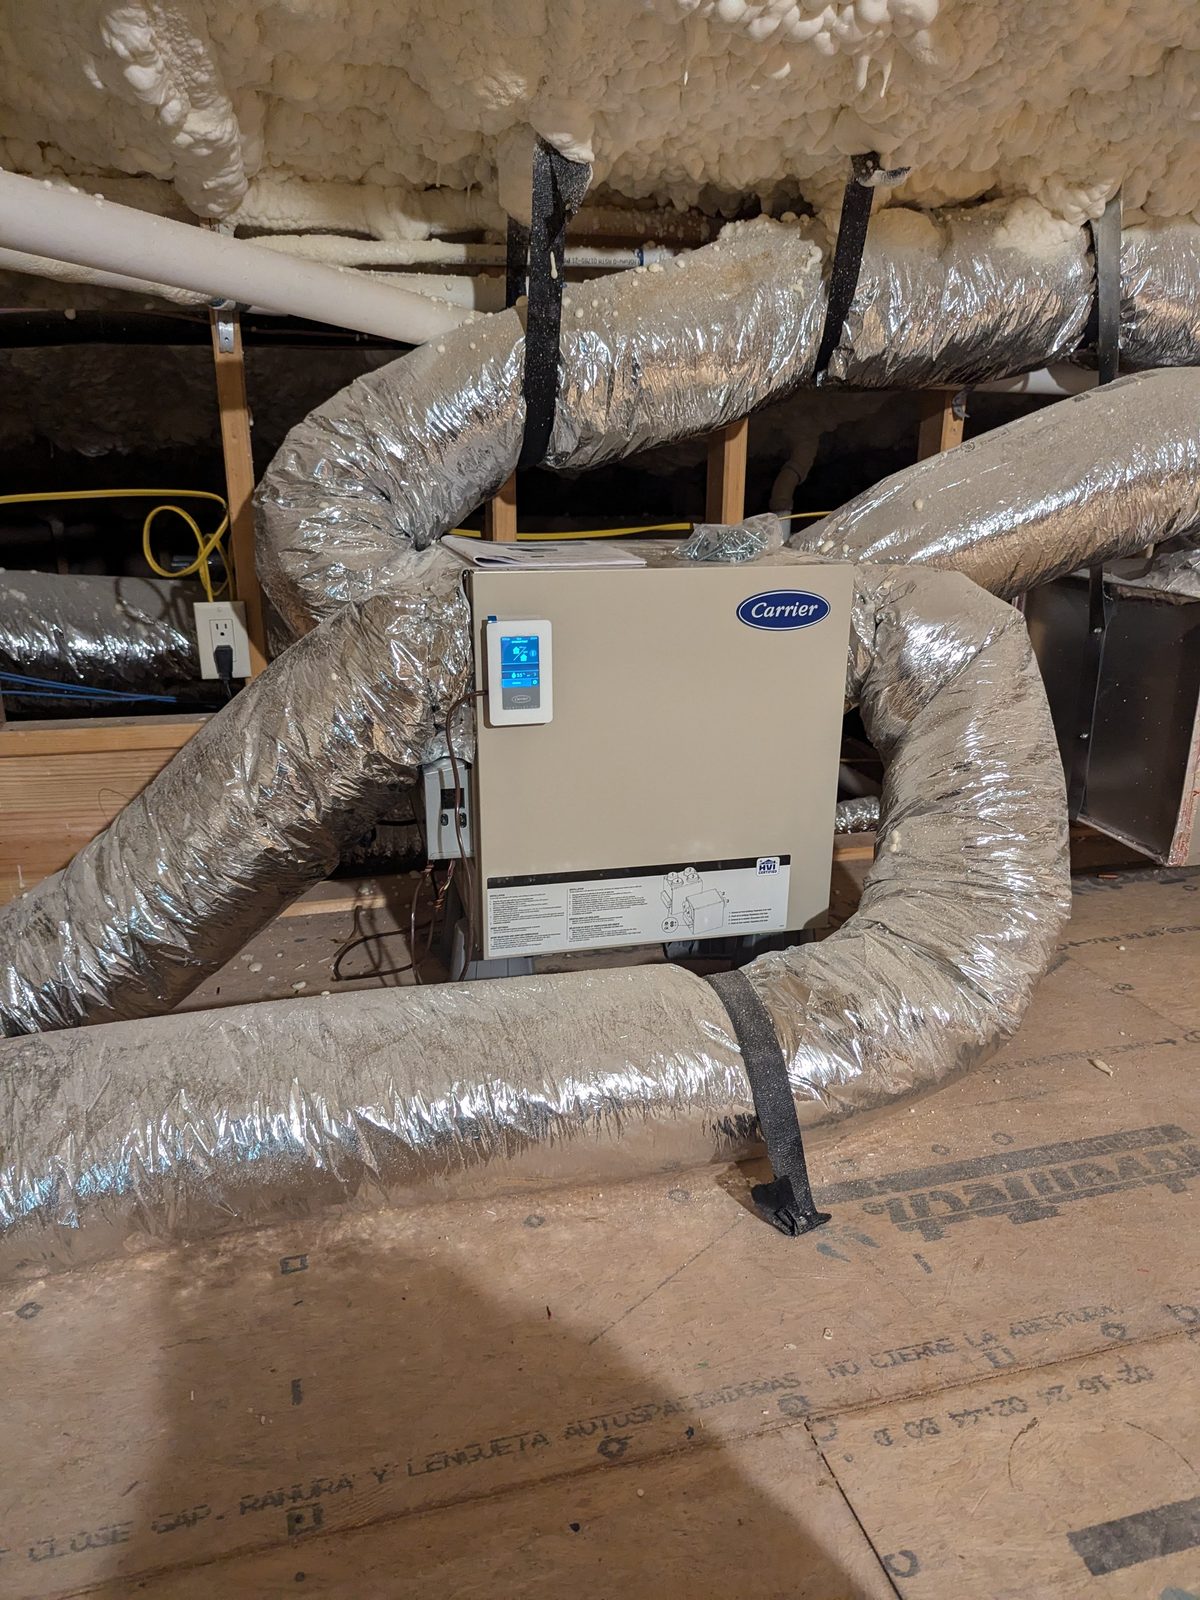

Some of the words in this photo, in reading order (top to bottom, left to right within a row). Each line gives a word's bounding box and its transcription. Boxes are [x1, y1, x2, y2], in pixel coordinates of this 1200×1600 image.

[751, 601, 818, 619] Carrier
[370, 1464, 390, 1484] Y
[963, 1329, 999, 1349] LA
